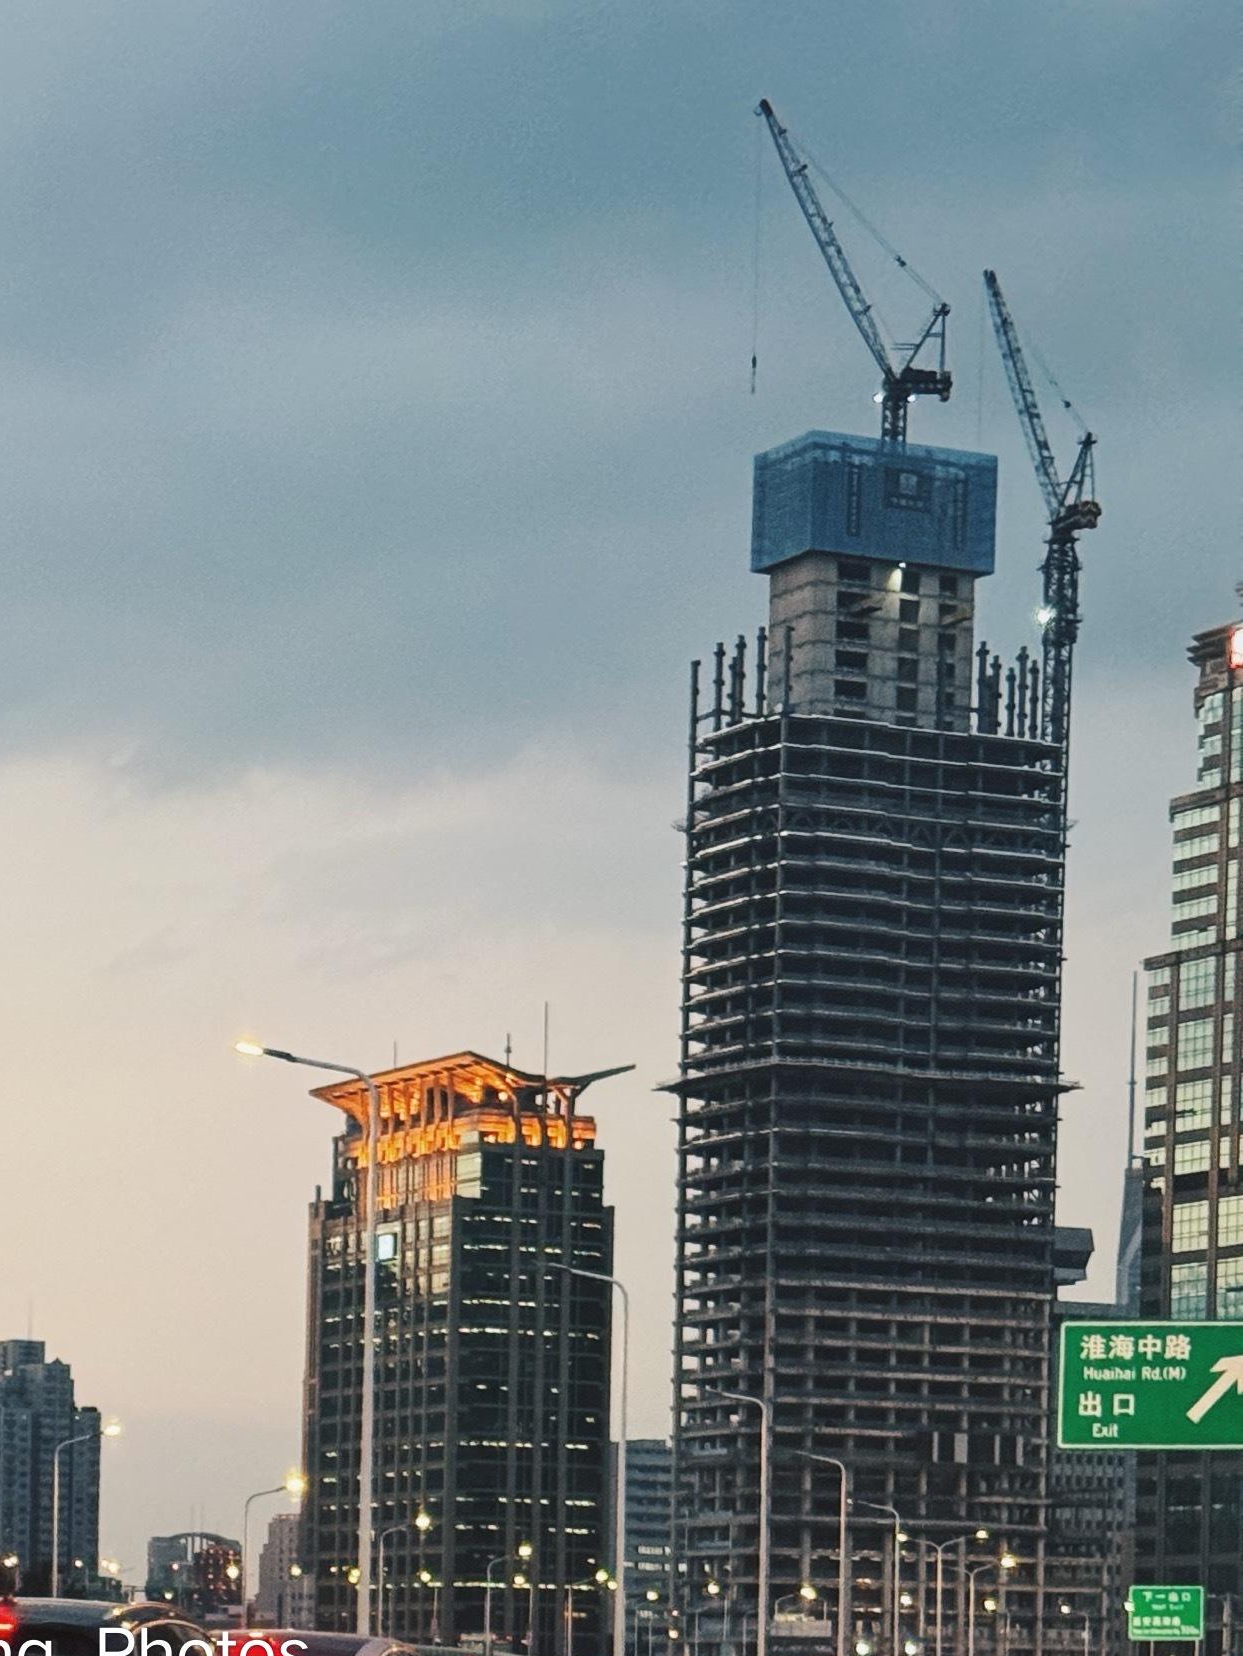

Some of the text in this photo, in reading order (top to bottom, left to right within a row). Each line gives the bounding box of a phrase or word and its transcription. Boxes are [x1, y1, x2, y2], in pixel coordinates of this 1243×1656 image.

[1079, 1334, 1192, 1361] 淮海中路
[1083, 1366, 1136, 1381] Huaihai
[1078, 1390, 1135, 1417] 出口
[1092, 1423, 1119, 1438] Exit
